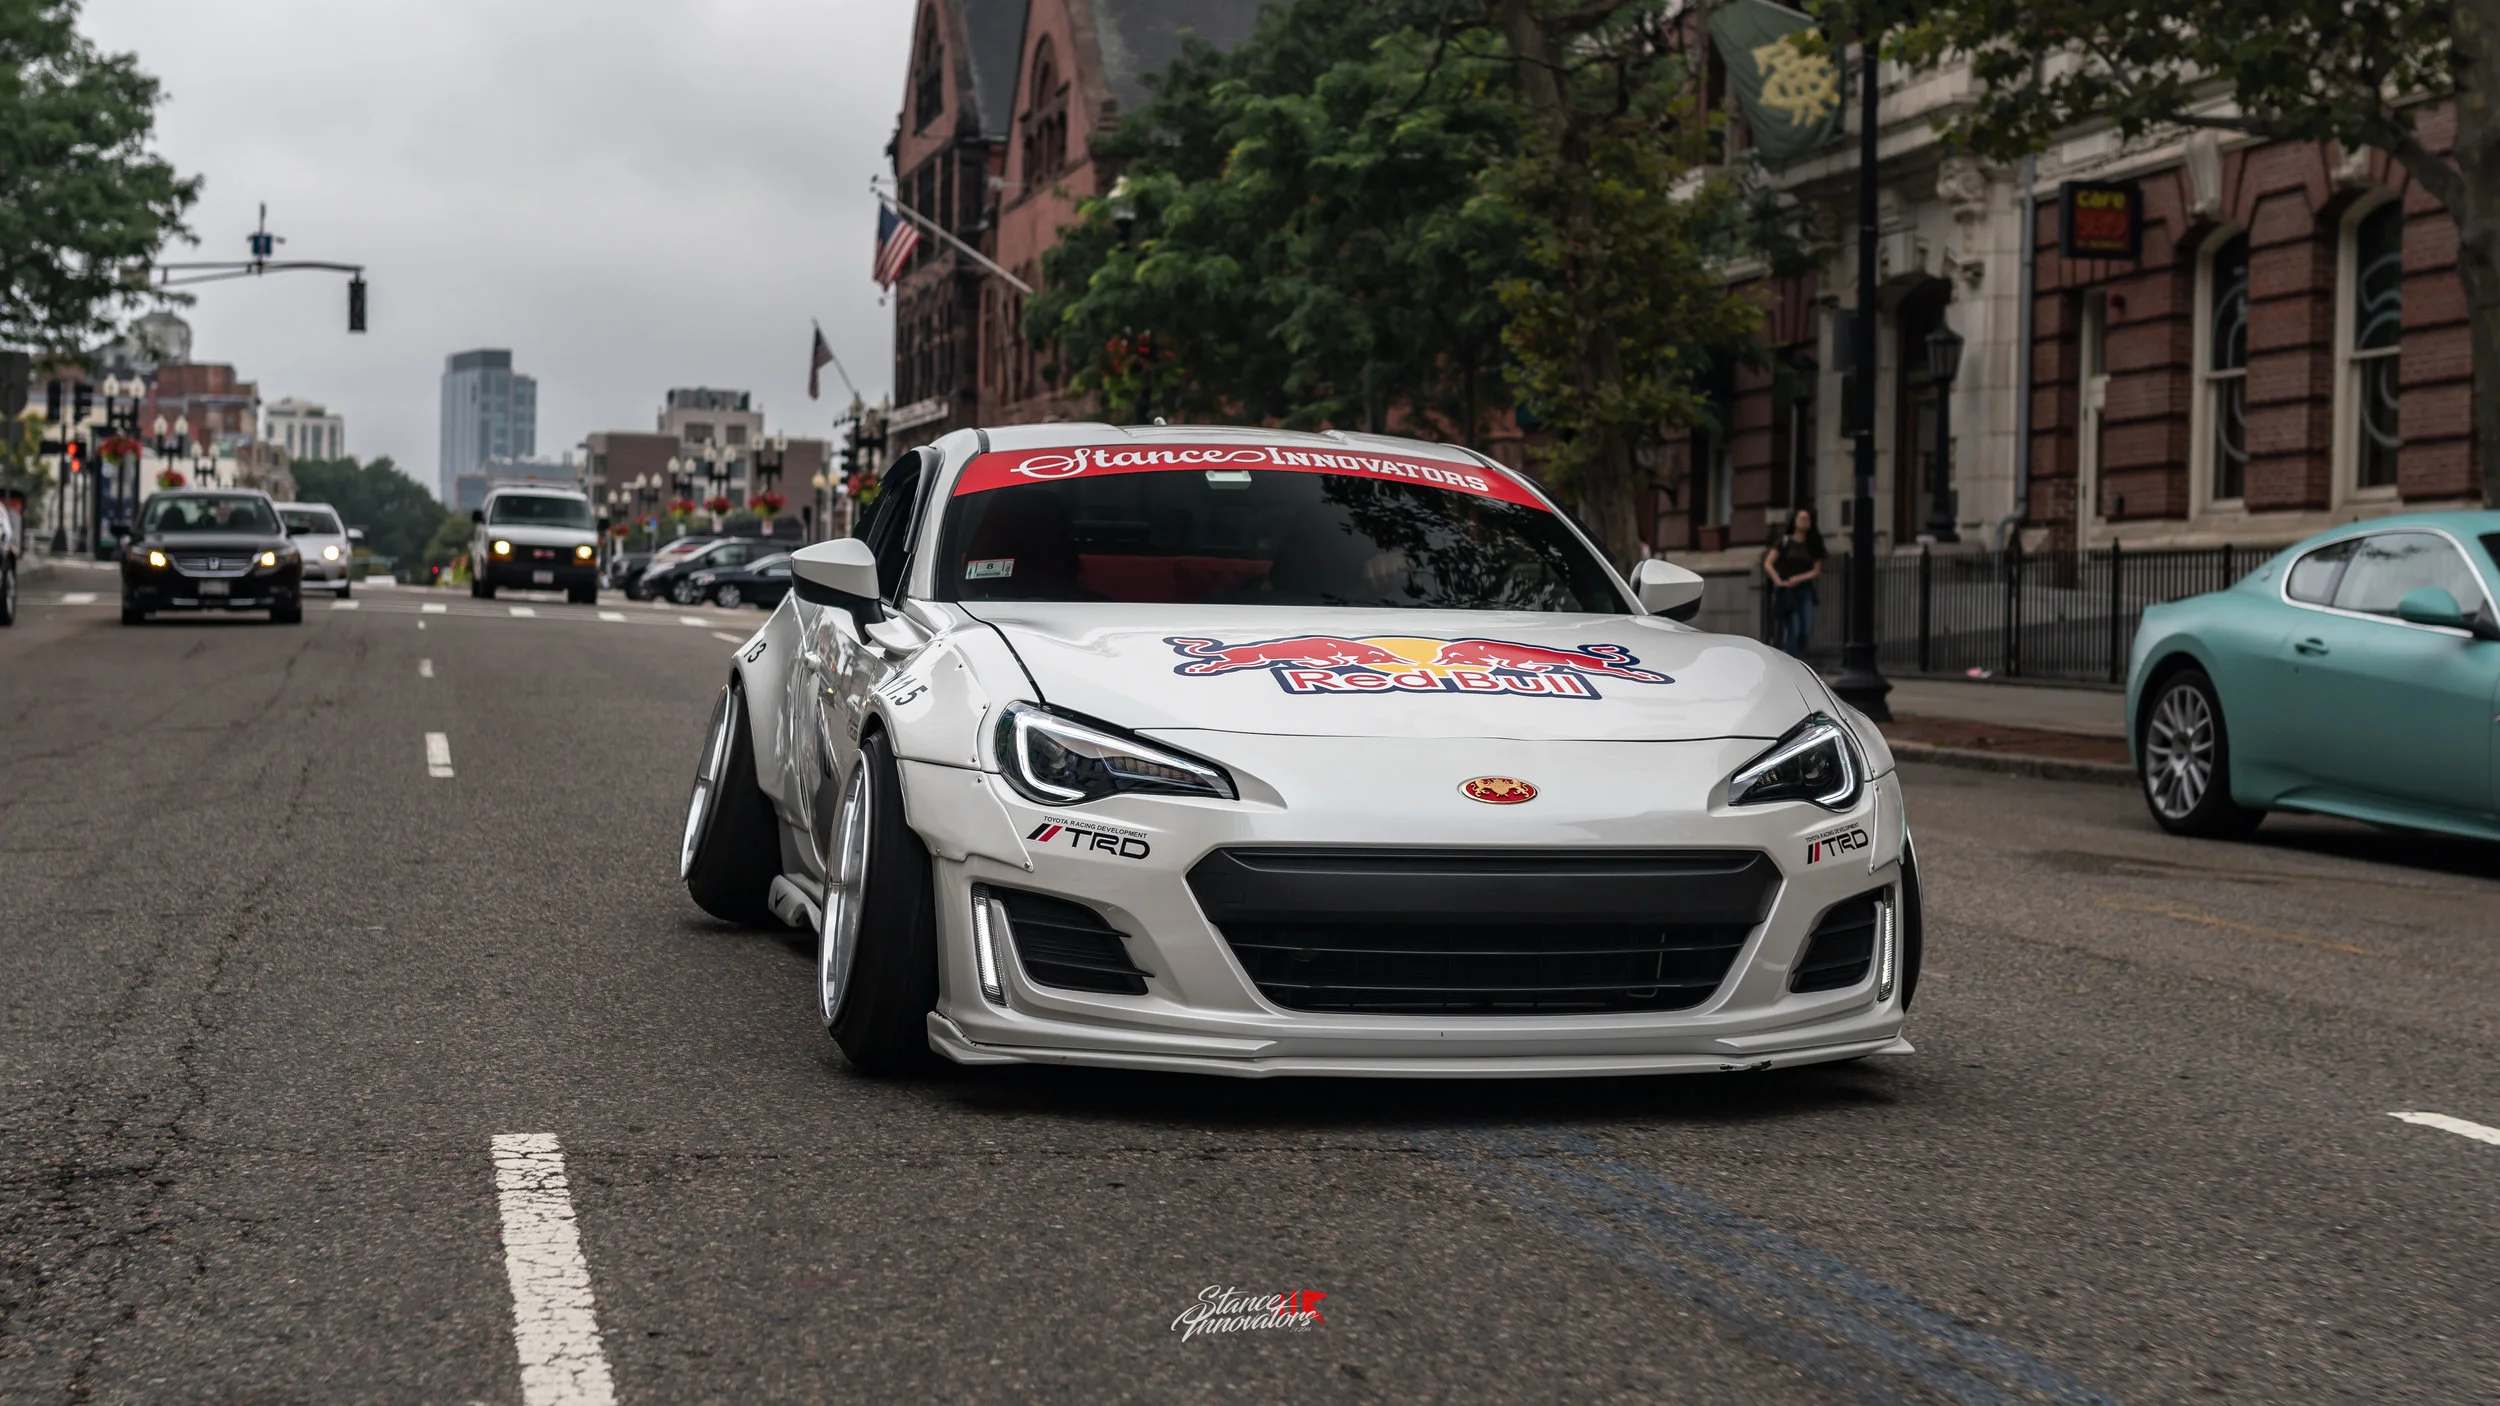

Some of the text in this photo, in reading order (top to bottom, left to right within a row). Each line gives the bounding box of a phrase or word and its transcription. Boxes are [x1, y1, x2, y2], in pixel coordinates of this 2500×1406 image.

[1010, 447, 1490, 492] Stance INNOVATORS
[1288, 669, 1585, 695] Red Bull
[1043, 815, 1148, 839] TOYOTA RACING DEVELOPMENT
[1064, 826, 1151, 860] TRD
[1820, 828, 1869, 857] TRD
